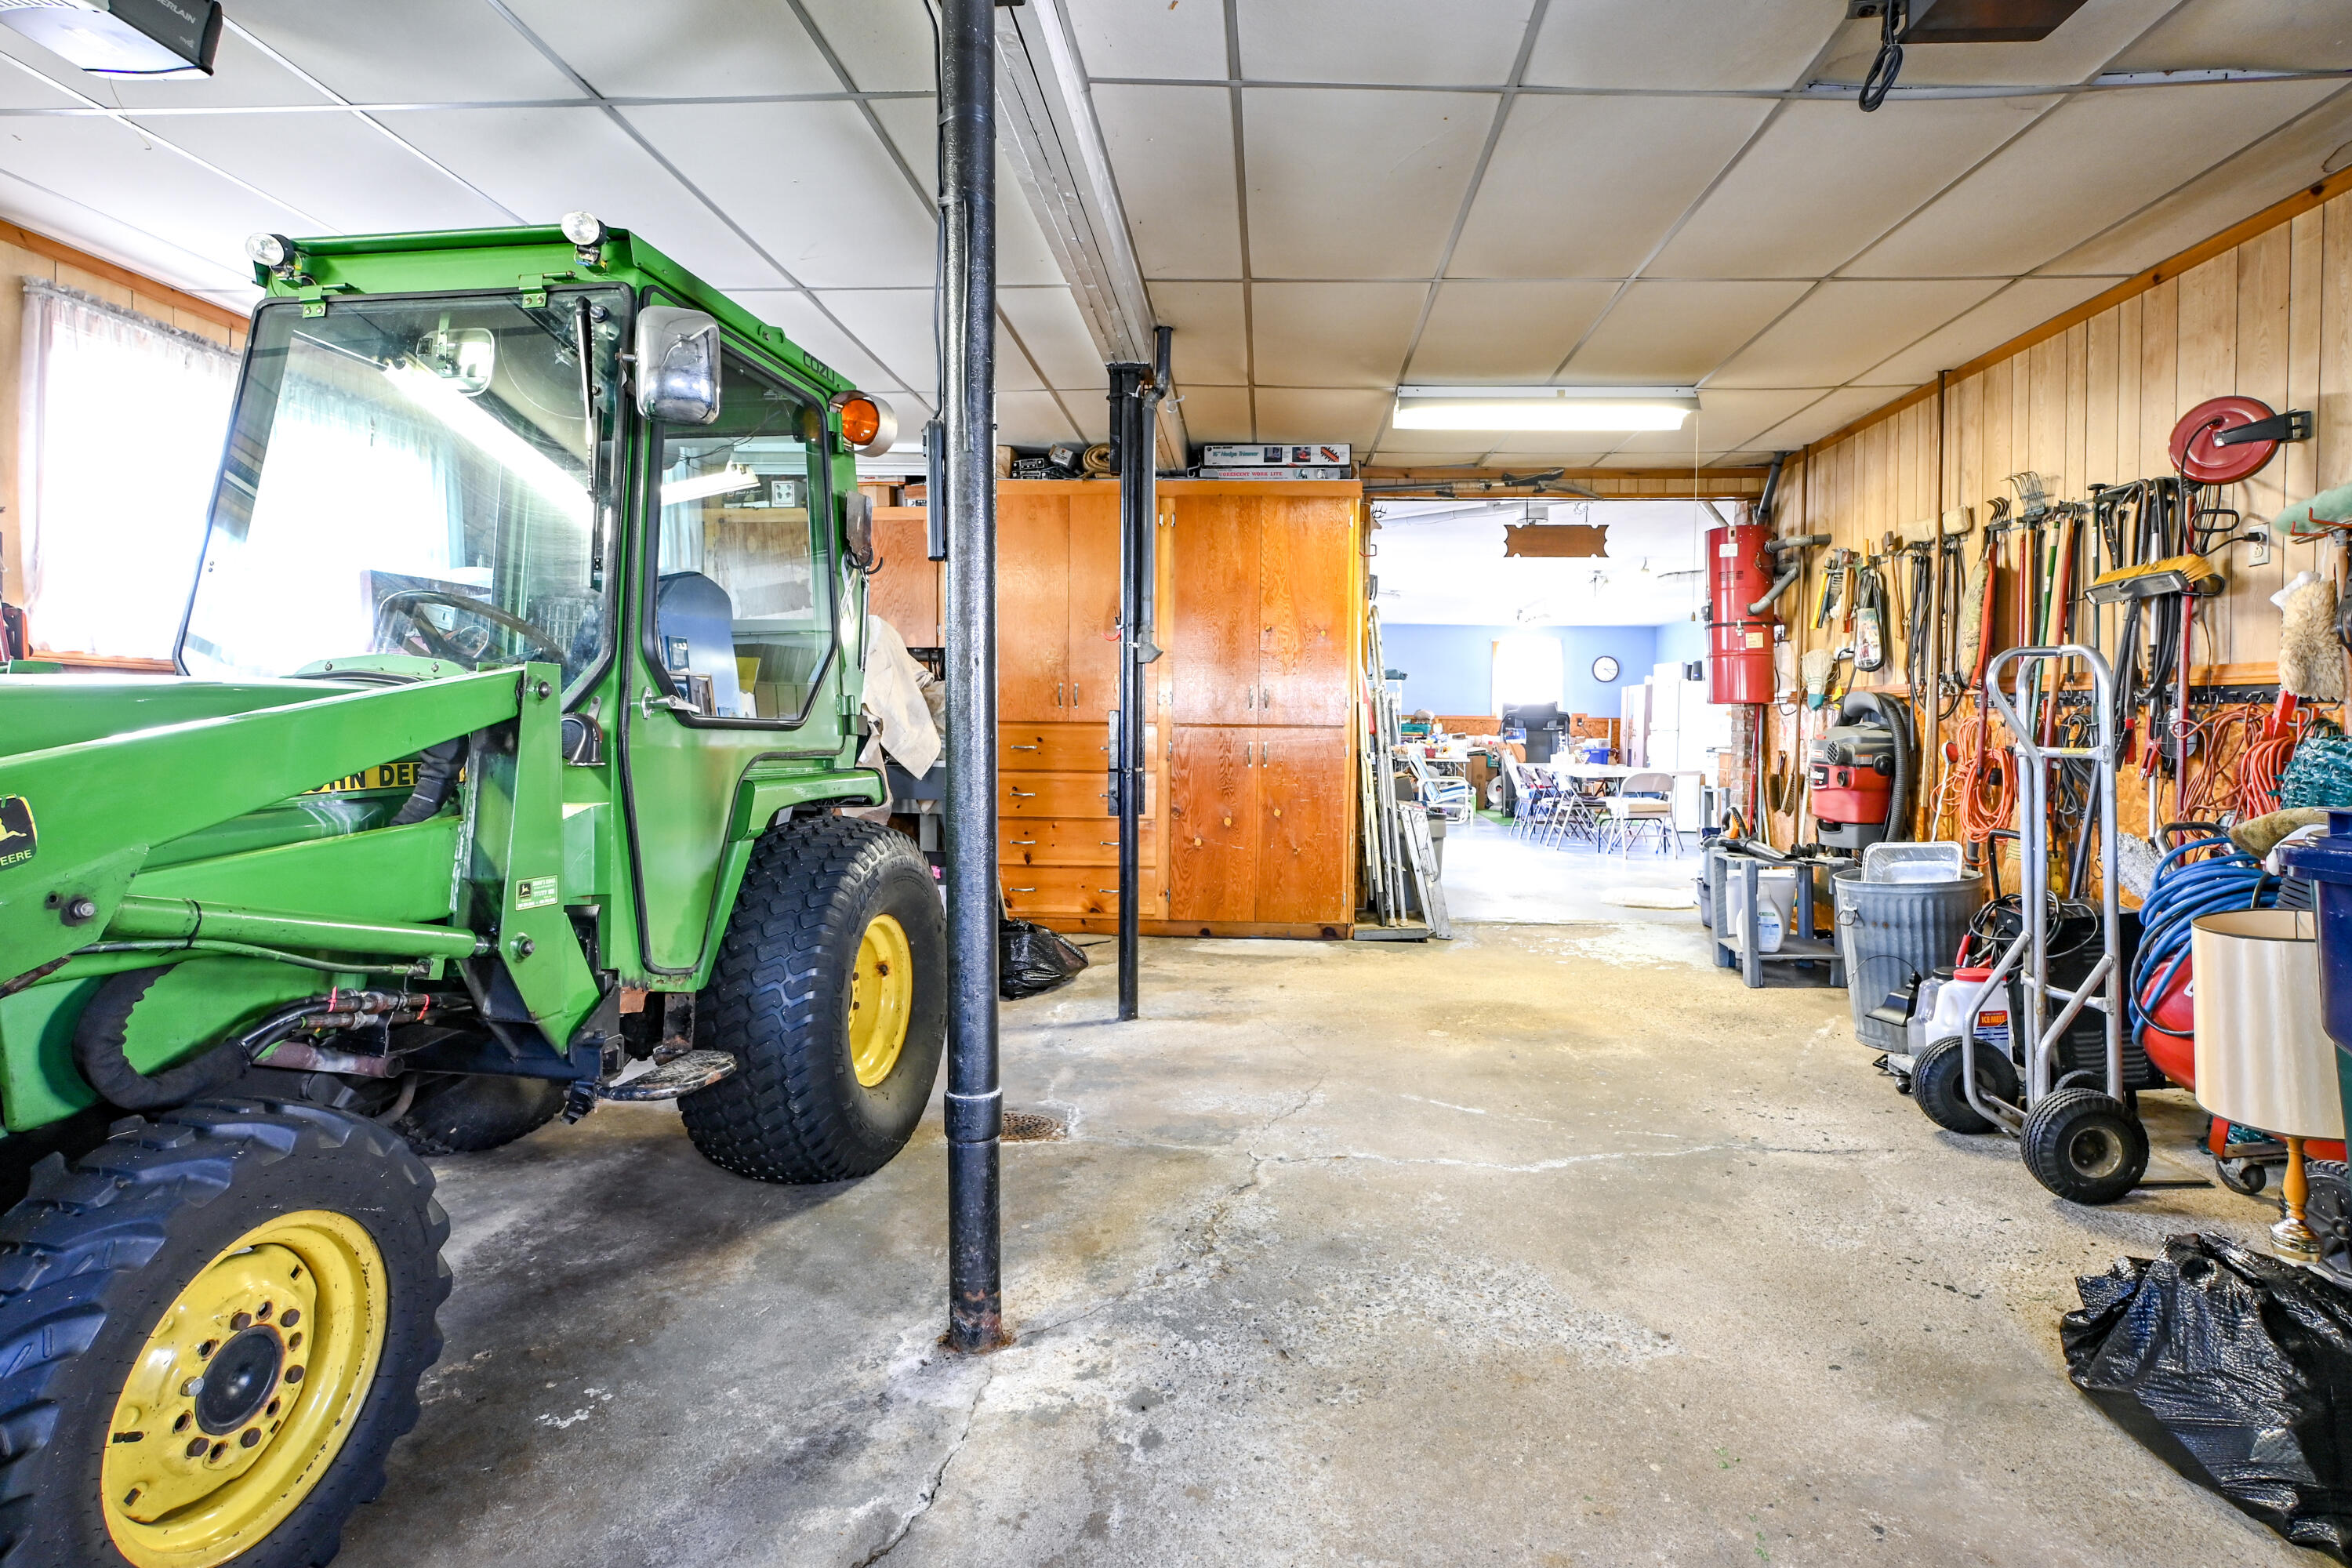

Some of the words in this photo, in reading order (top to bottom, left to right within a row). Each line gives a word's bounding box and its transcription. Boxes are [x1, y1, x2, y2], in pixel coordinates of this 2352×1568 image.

[158, 0, 196, 24] ERLAIN
[0, 849, 33, 866] EERE
[1981, 1015, 1991, 1024] ICE
